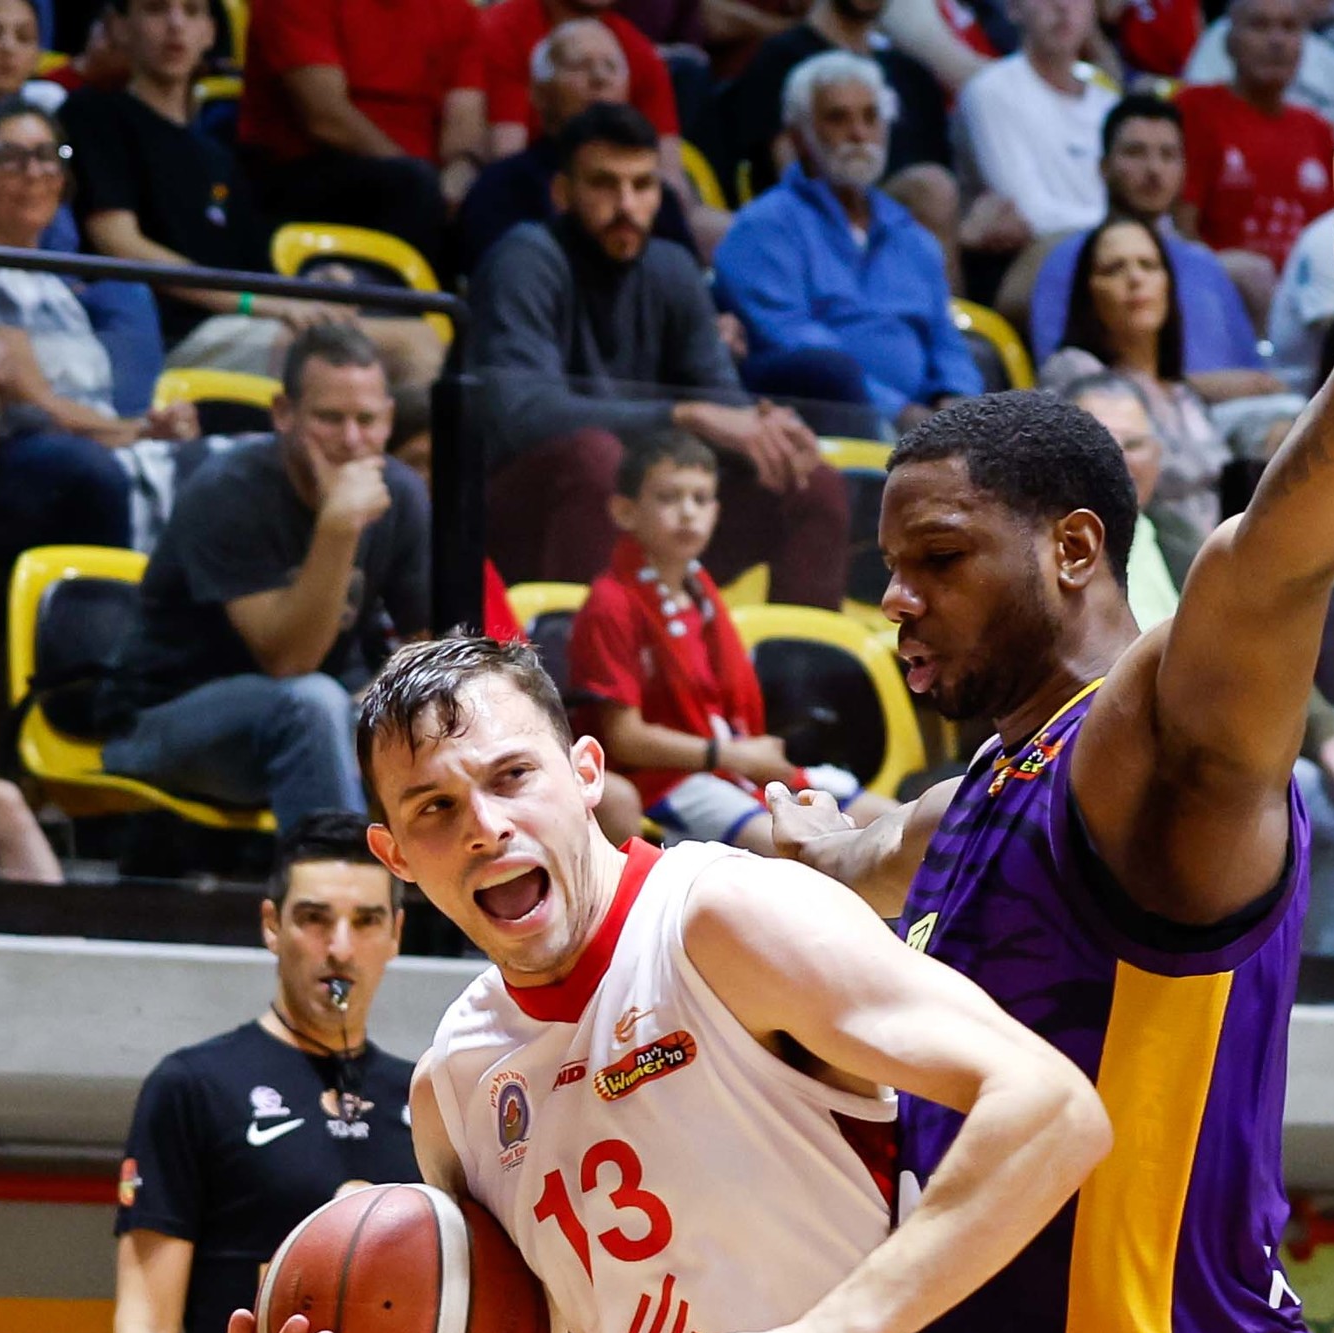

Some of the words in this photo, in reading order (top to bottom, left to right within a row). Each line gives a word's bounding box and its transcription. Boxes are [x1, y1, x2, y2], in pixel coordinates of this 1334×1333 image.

[636, 1045, 662, 1067] ליגת
[606, 1057, 667, 1094] Winner
[532, 1137, 673, 1287] 13
